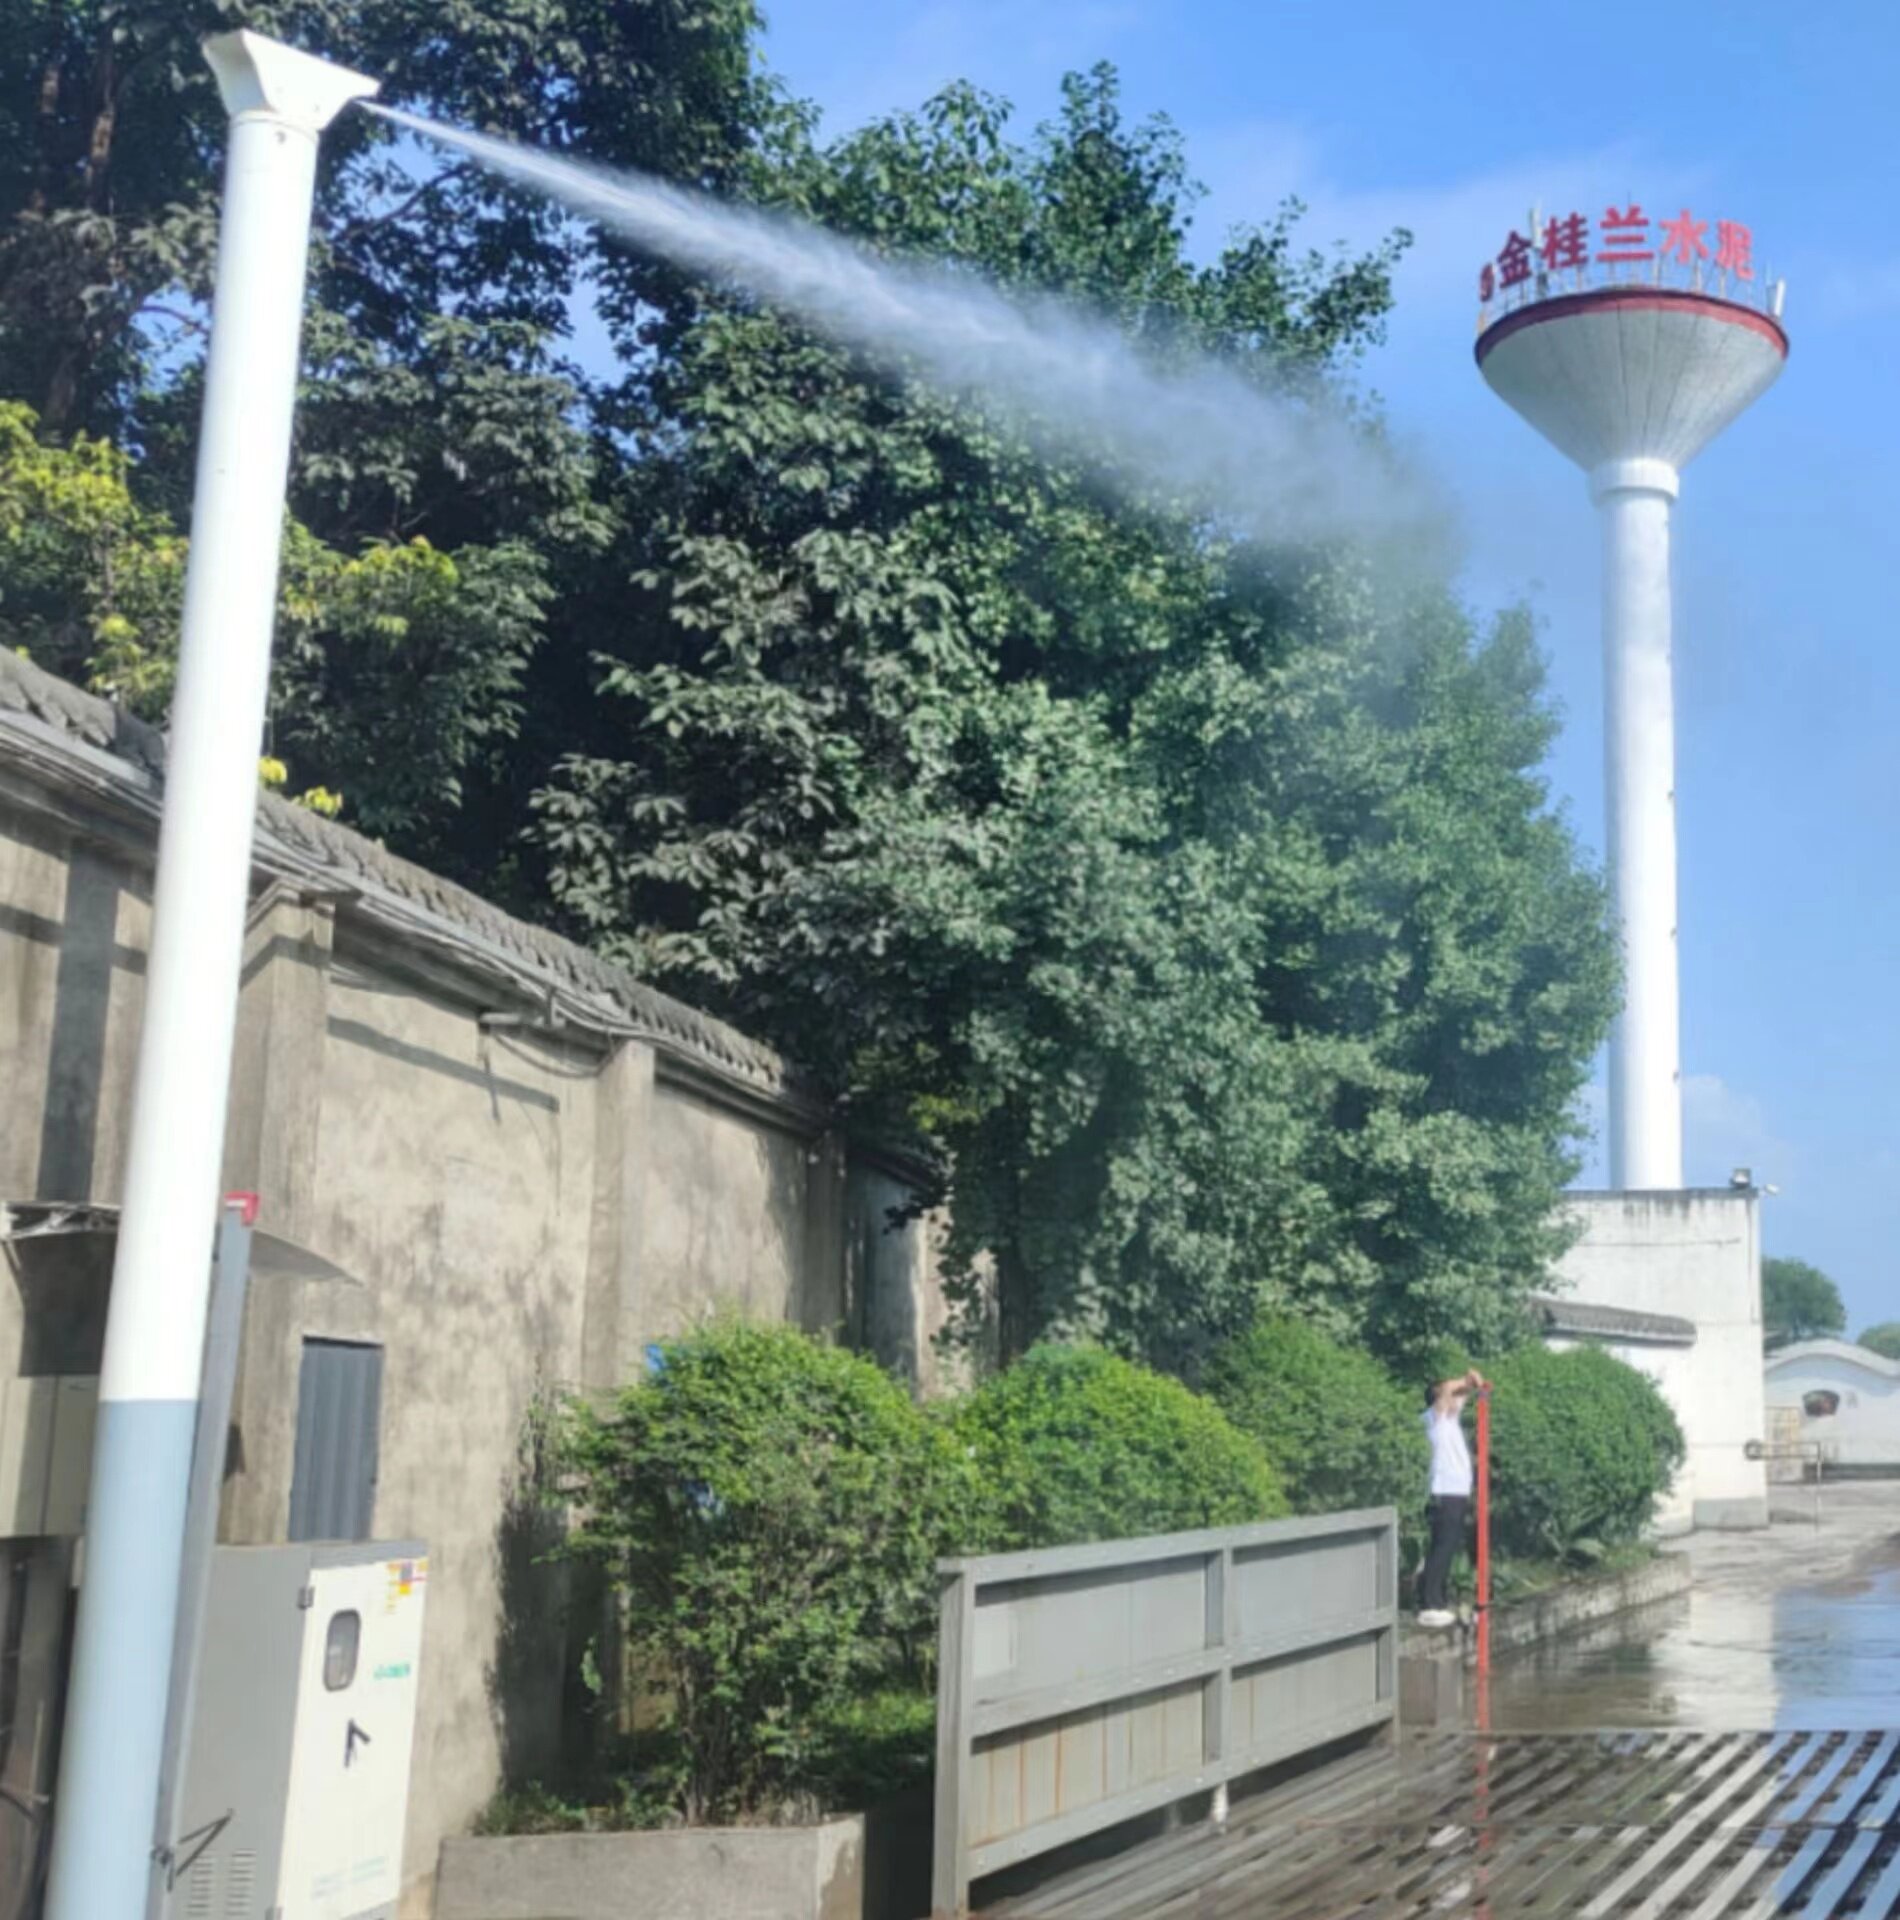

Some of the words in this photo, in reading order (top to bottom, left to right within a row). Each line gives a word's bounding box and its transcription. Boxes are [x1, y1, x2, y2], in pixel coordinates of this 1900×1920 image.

[1480, 205, 1754, 302] 金桂兰水泥
